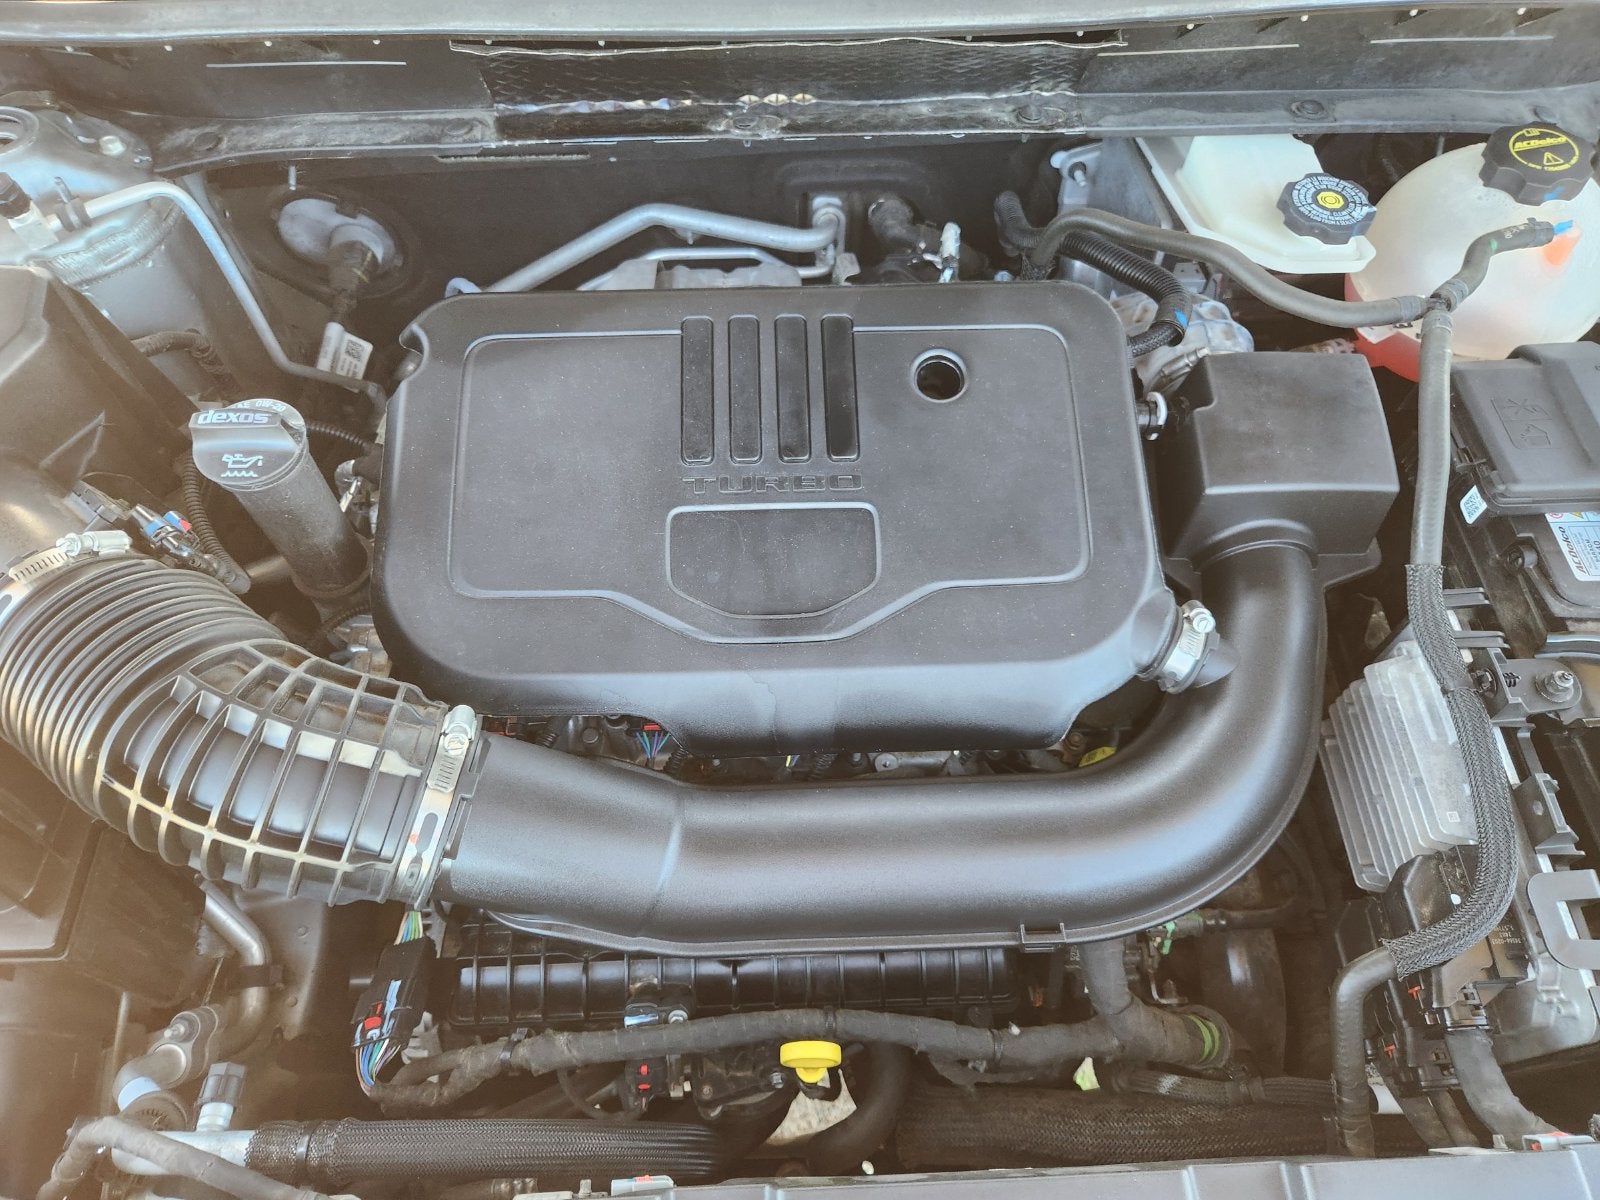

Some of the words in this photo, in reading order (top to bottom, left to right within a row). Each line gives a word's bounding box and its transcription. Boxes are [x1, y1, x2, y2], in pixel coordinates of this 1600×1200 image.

[255, 400, 287, 412] 0W-20
[197, 410, 272, 425] dexos
[682, 474, 863, 494] TURBO
[1558, 526, 1587, 575] ACDelco
